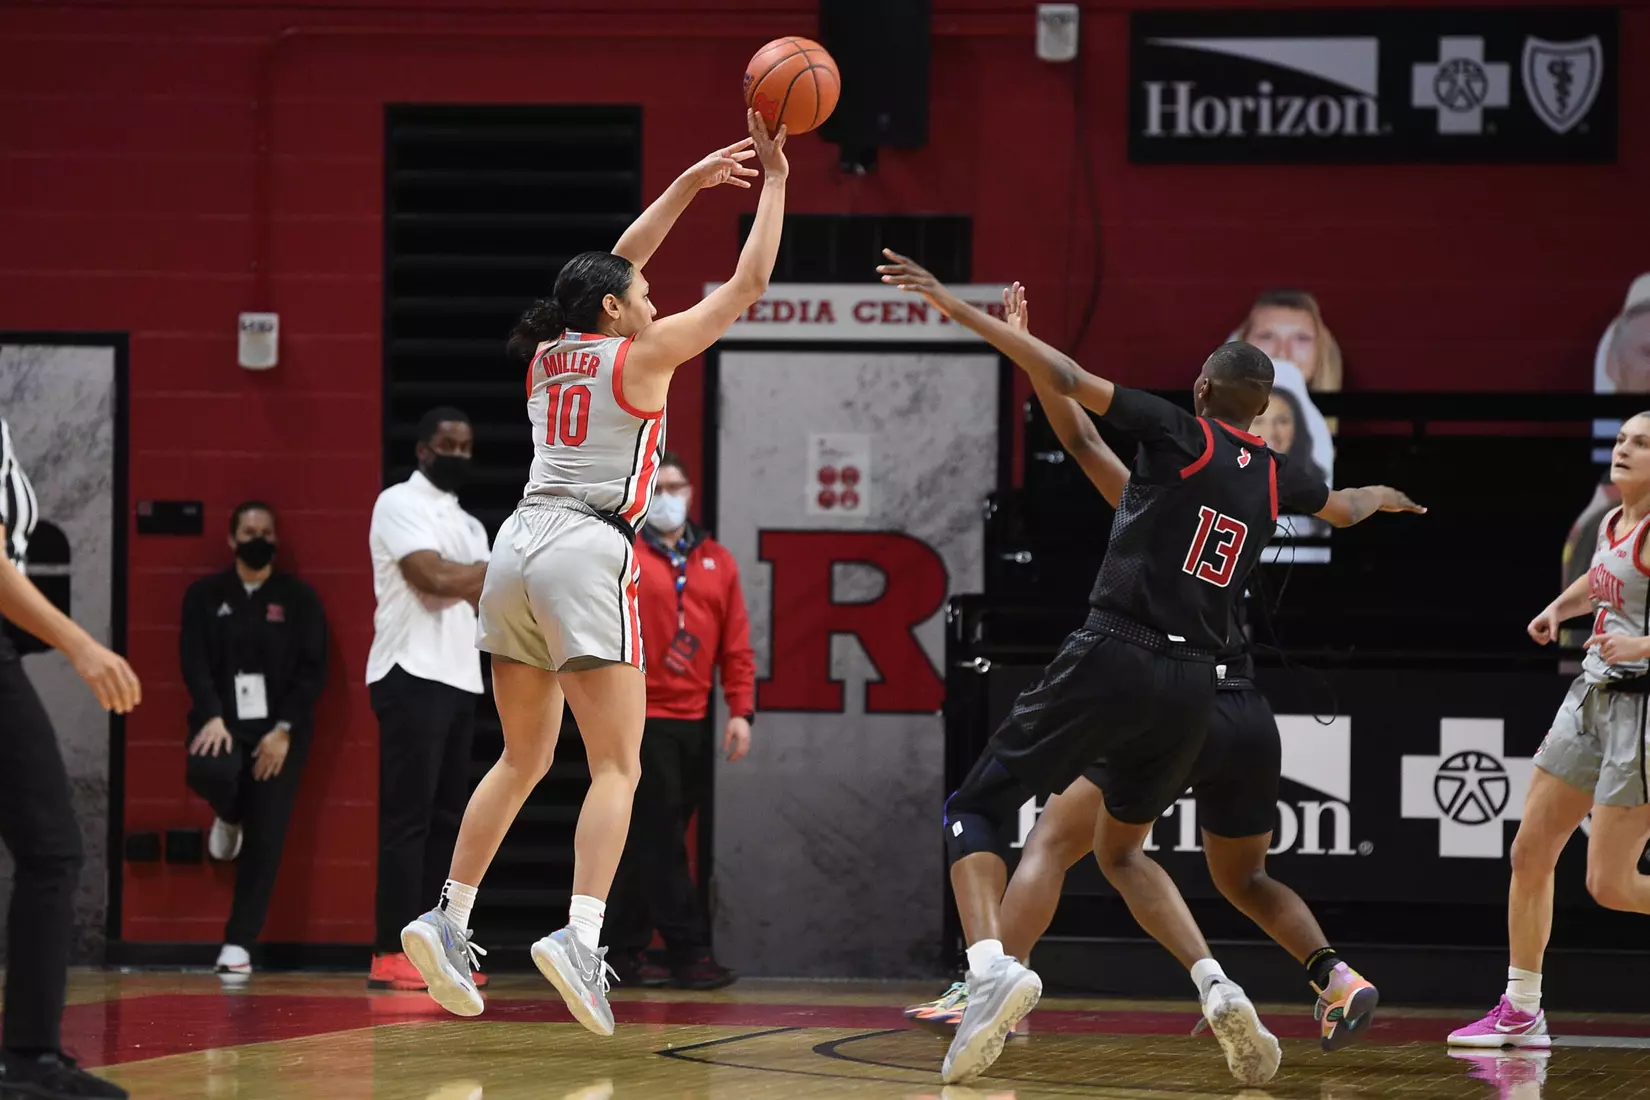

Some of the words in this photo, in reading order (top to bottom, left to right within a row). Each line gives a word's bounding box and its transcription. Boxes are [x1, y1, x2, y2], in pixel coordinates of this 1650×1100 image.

[1142, 80, 1381, 137] Horizon
[735, 299, 836, 324] EDIA
[853, 299, 1010, 324] CENR
[542, 352, 600, 378] MILLER
[546, 383, 591, 447] 10
[1182, 505, 1248, 587] 13
[756, 529, 949, 714] R
